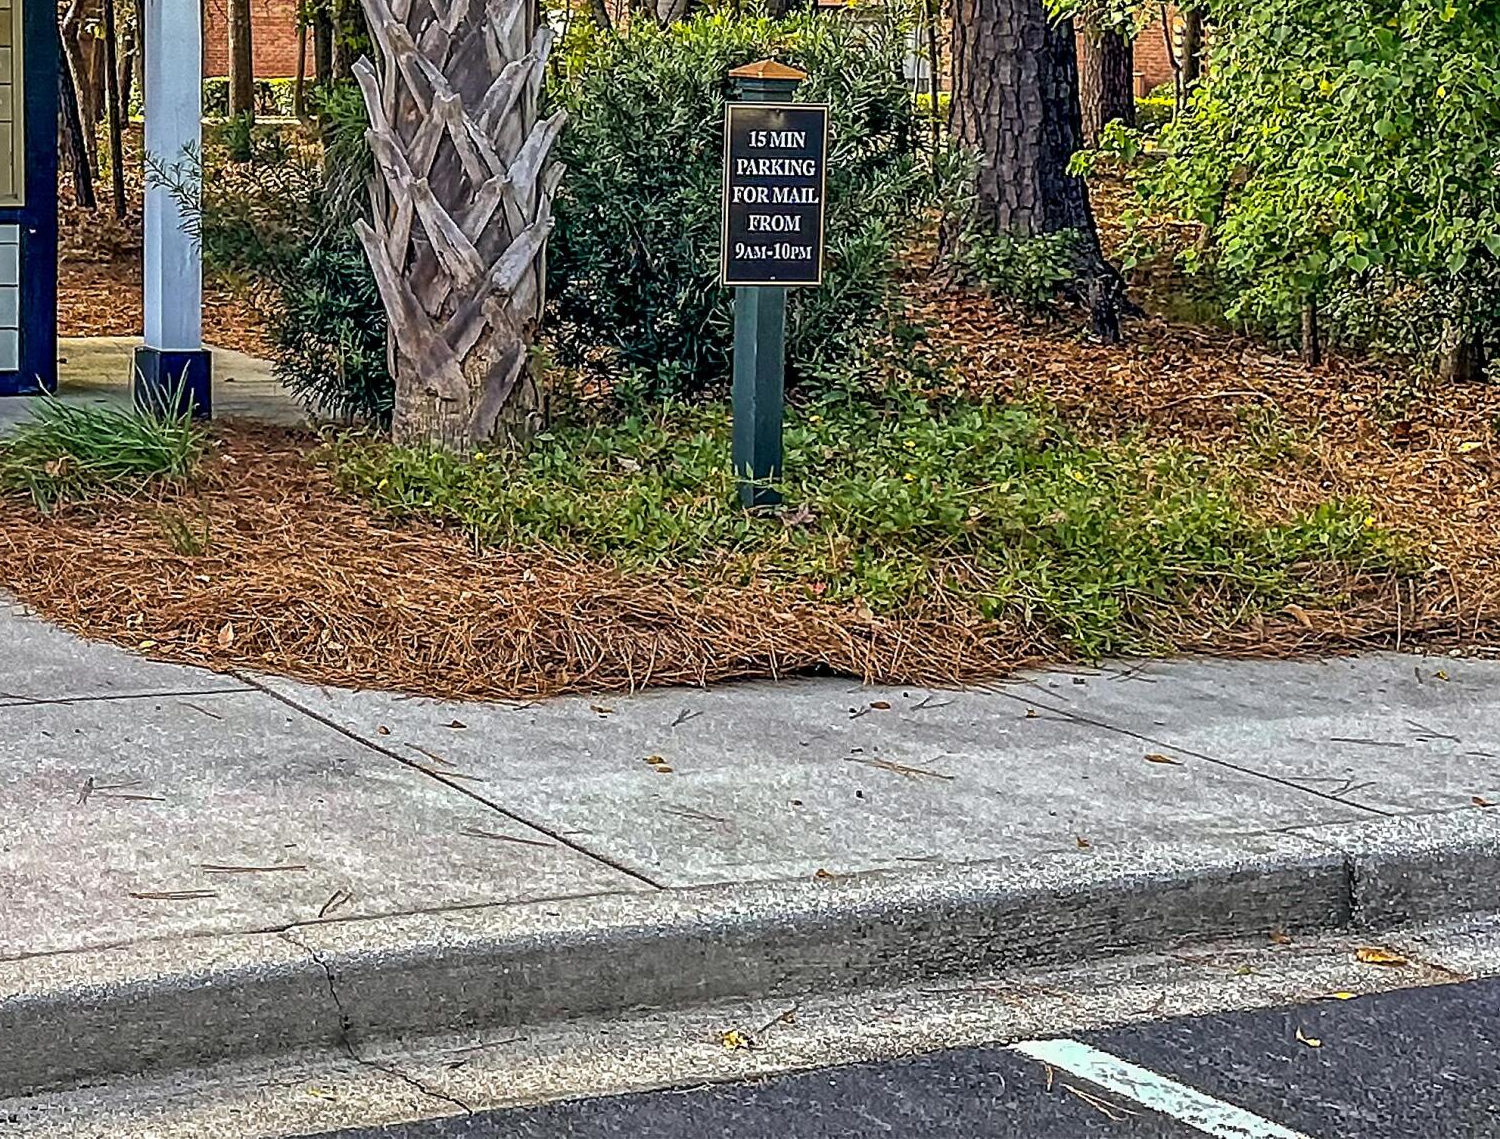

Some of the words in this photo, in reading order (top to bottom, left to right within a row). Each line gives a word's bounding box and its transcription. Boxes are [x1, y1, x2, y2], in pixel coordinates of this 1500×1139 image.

[749, 131, 766, 147] 15
[769, 131, 805, 148] MIN
[736, 159, 815, 176] PARKING
[732, 186, 769, 203] FOR
[772, 187, 819, 203] MAIL
[747, 215, 801, 231] FROM
[735, 242, 812, 260] 9AM-10PM
